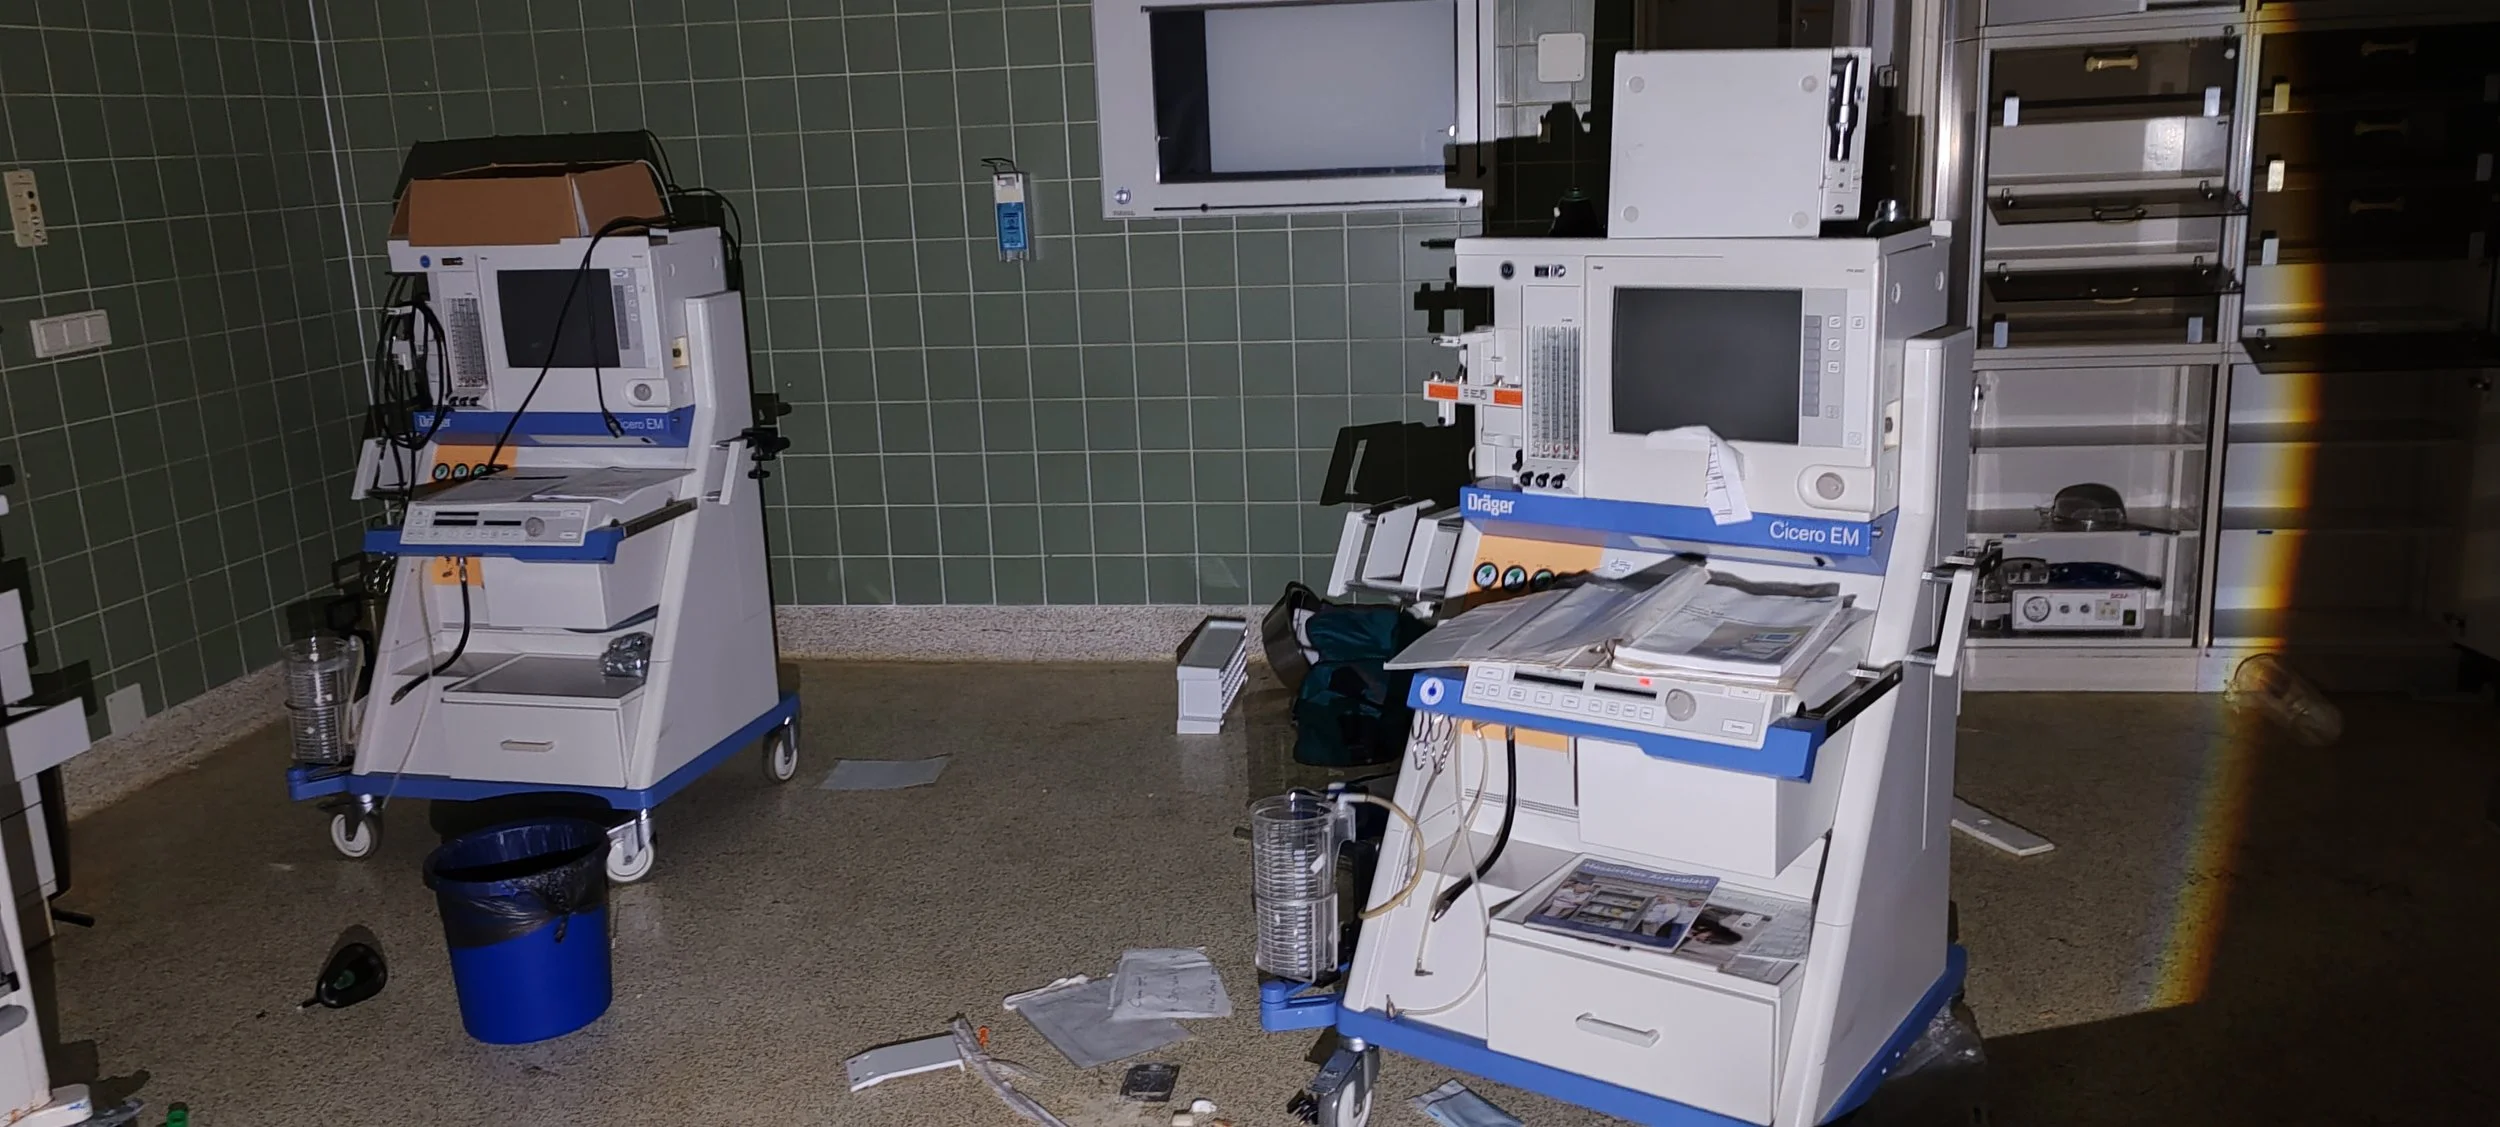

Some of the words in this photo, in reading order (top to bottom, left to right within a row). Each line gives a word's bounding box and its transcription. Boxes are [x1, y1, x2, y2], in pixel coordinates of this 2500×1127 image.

[646, 418, 664, 430] EM
[1467, 493, 1516, 517] Dräger
[1769, 521, 1826, 543] Cicero
[1830, 526, 1860, 547] EM
